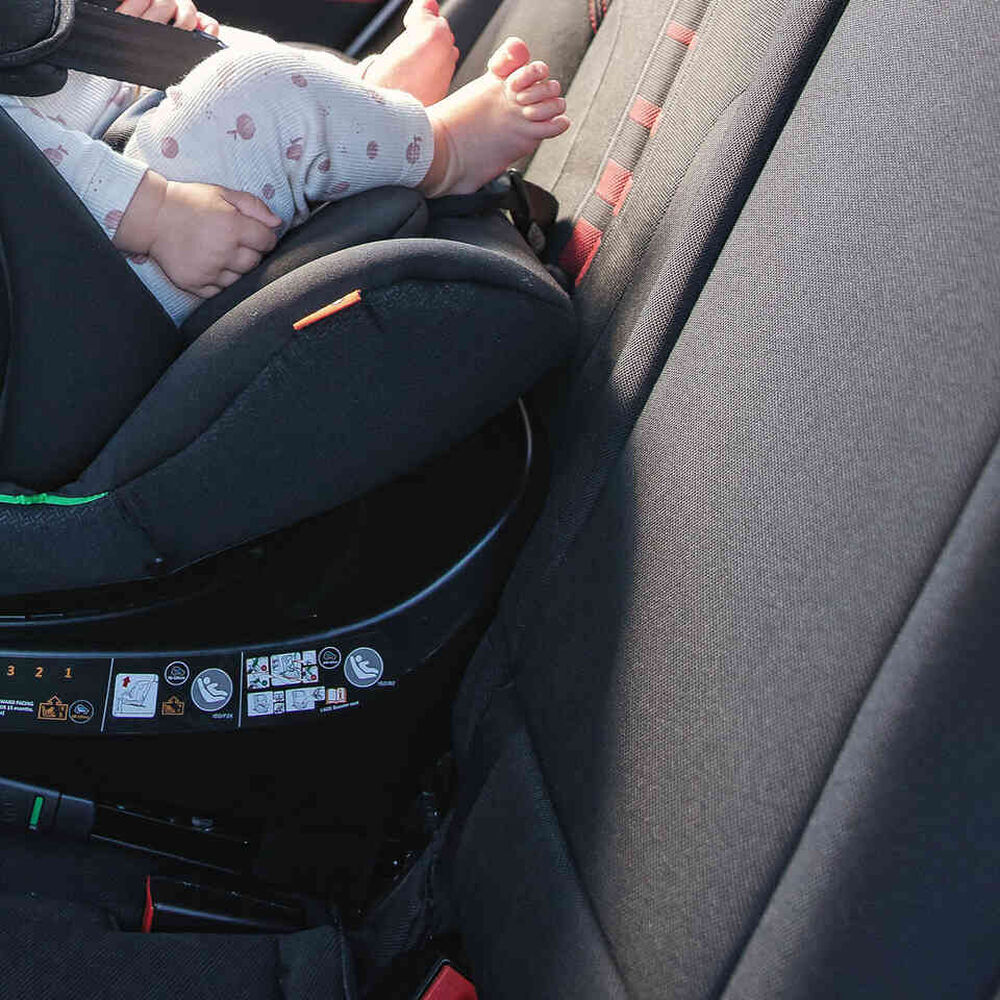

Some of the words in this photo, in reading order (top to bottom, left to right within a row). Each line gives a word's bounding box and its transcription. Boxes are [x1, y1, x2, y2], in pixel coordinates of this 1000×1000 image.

[7, 665, 15, 676] 3
[35, 666, 43, 678] 2
[65, 667, 73, 679] 1
